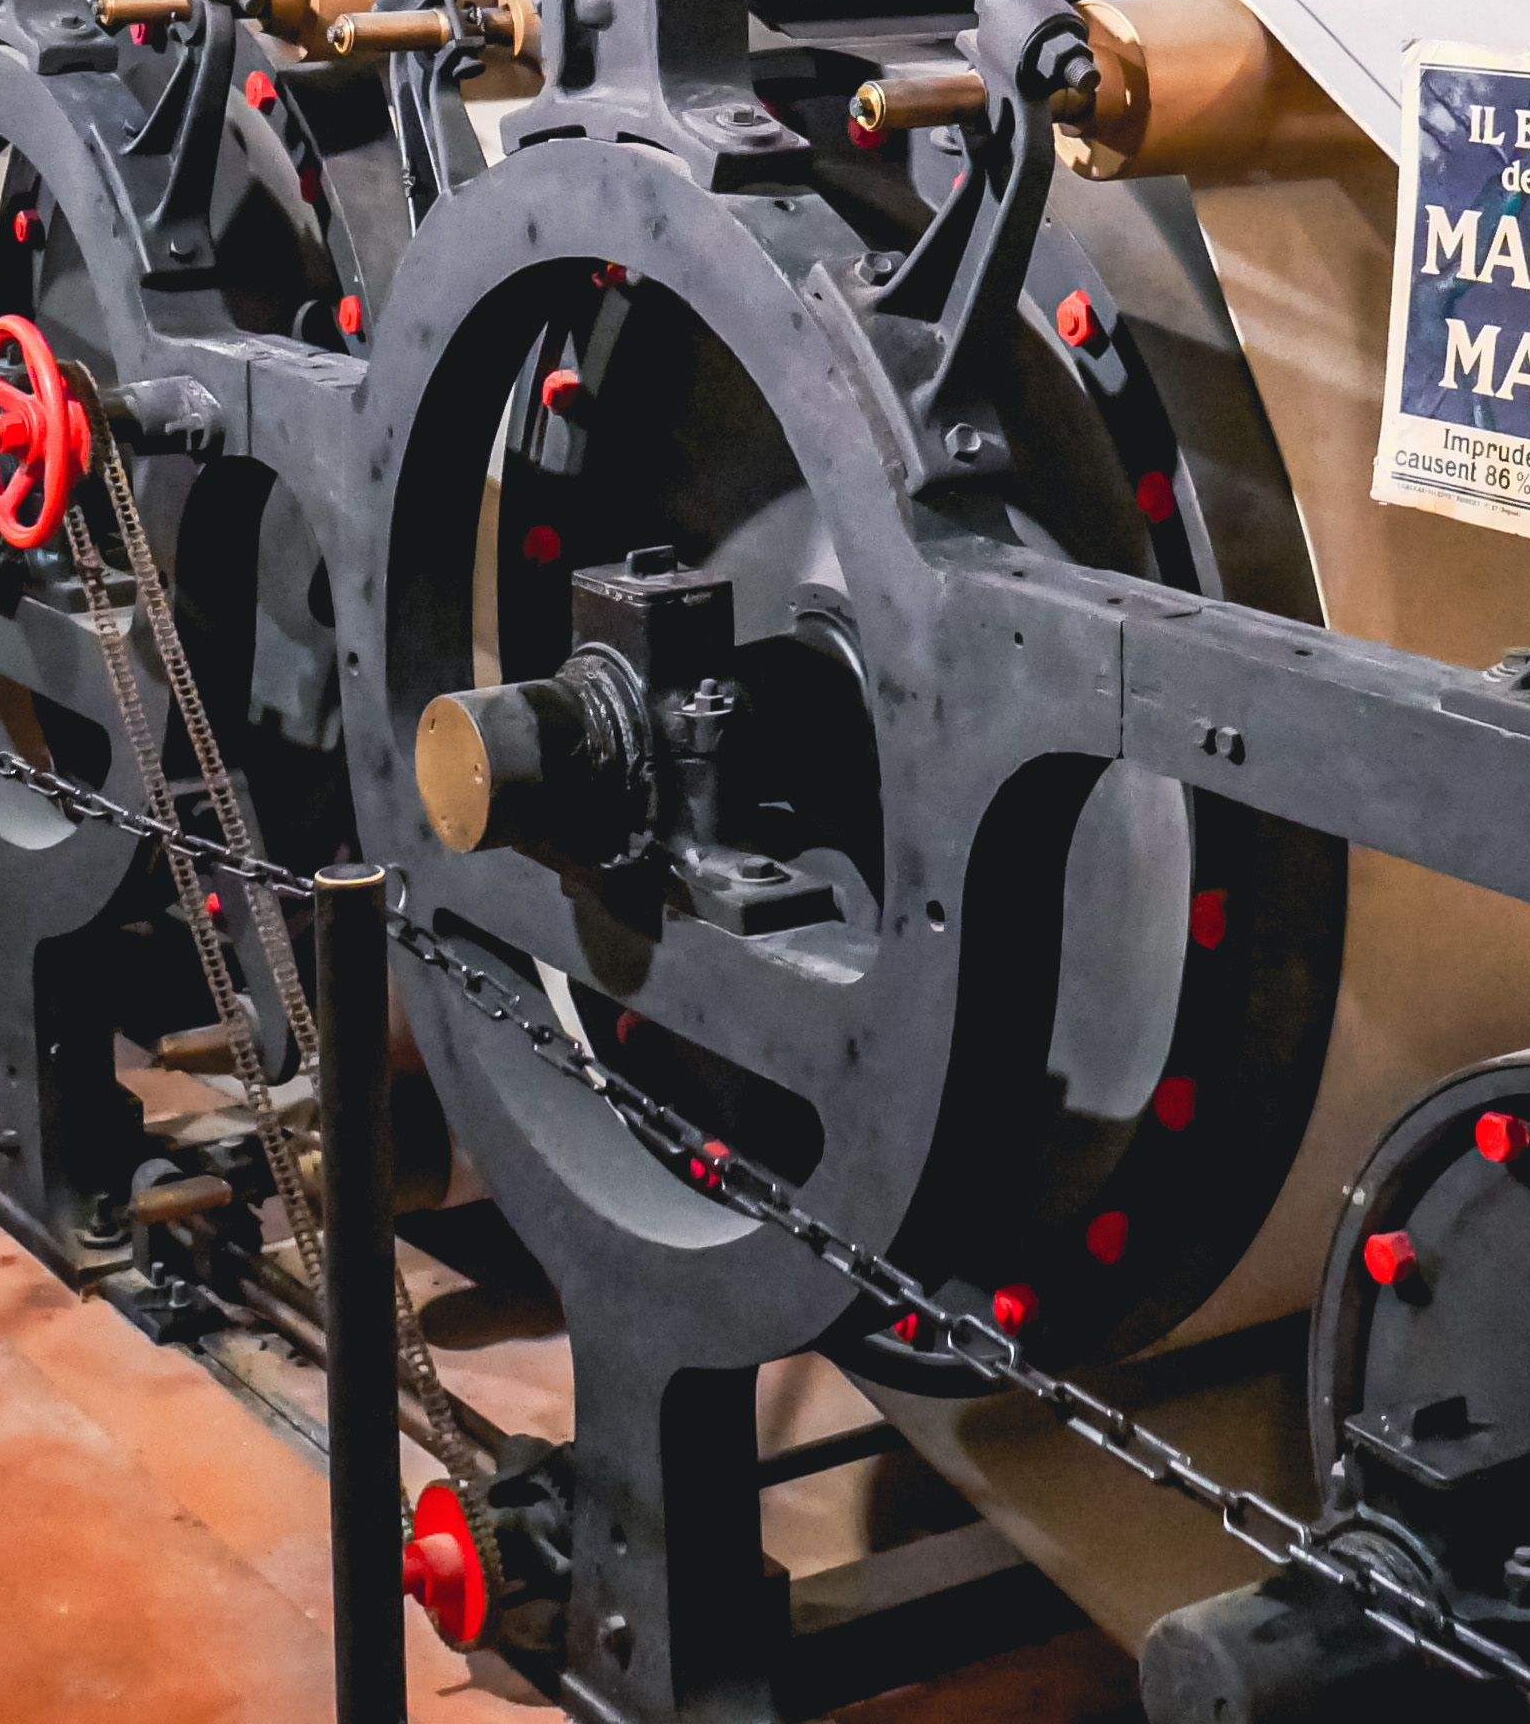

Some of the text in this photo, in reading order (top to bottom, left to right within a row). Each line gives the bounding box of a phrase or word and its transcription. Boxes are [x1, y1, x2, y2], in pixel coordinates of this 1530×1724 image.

[1469, 104, 1505, 145] IL
[1395, 449, 1477, 484] causent
[1485, 465, 1511, 492] 86
